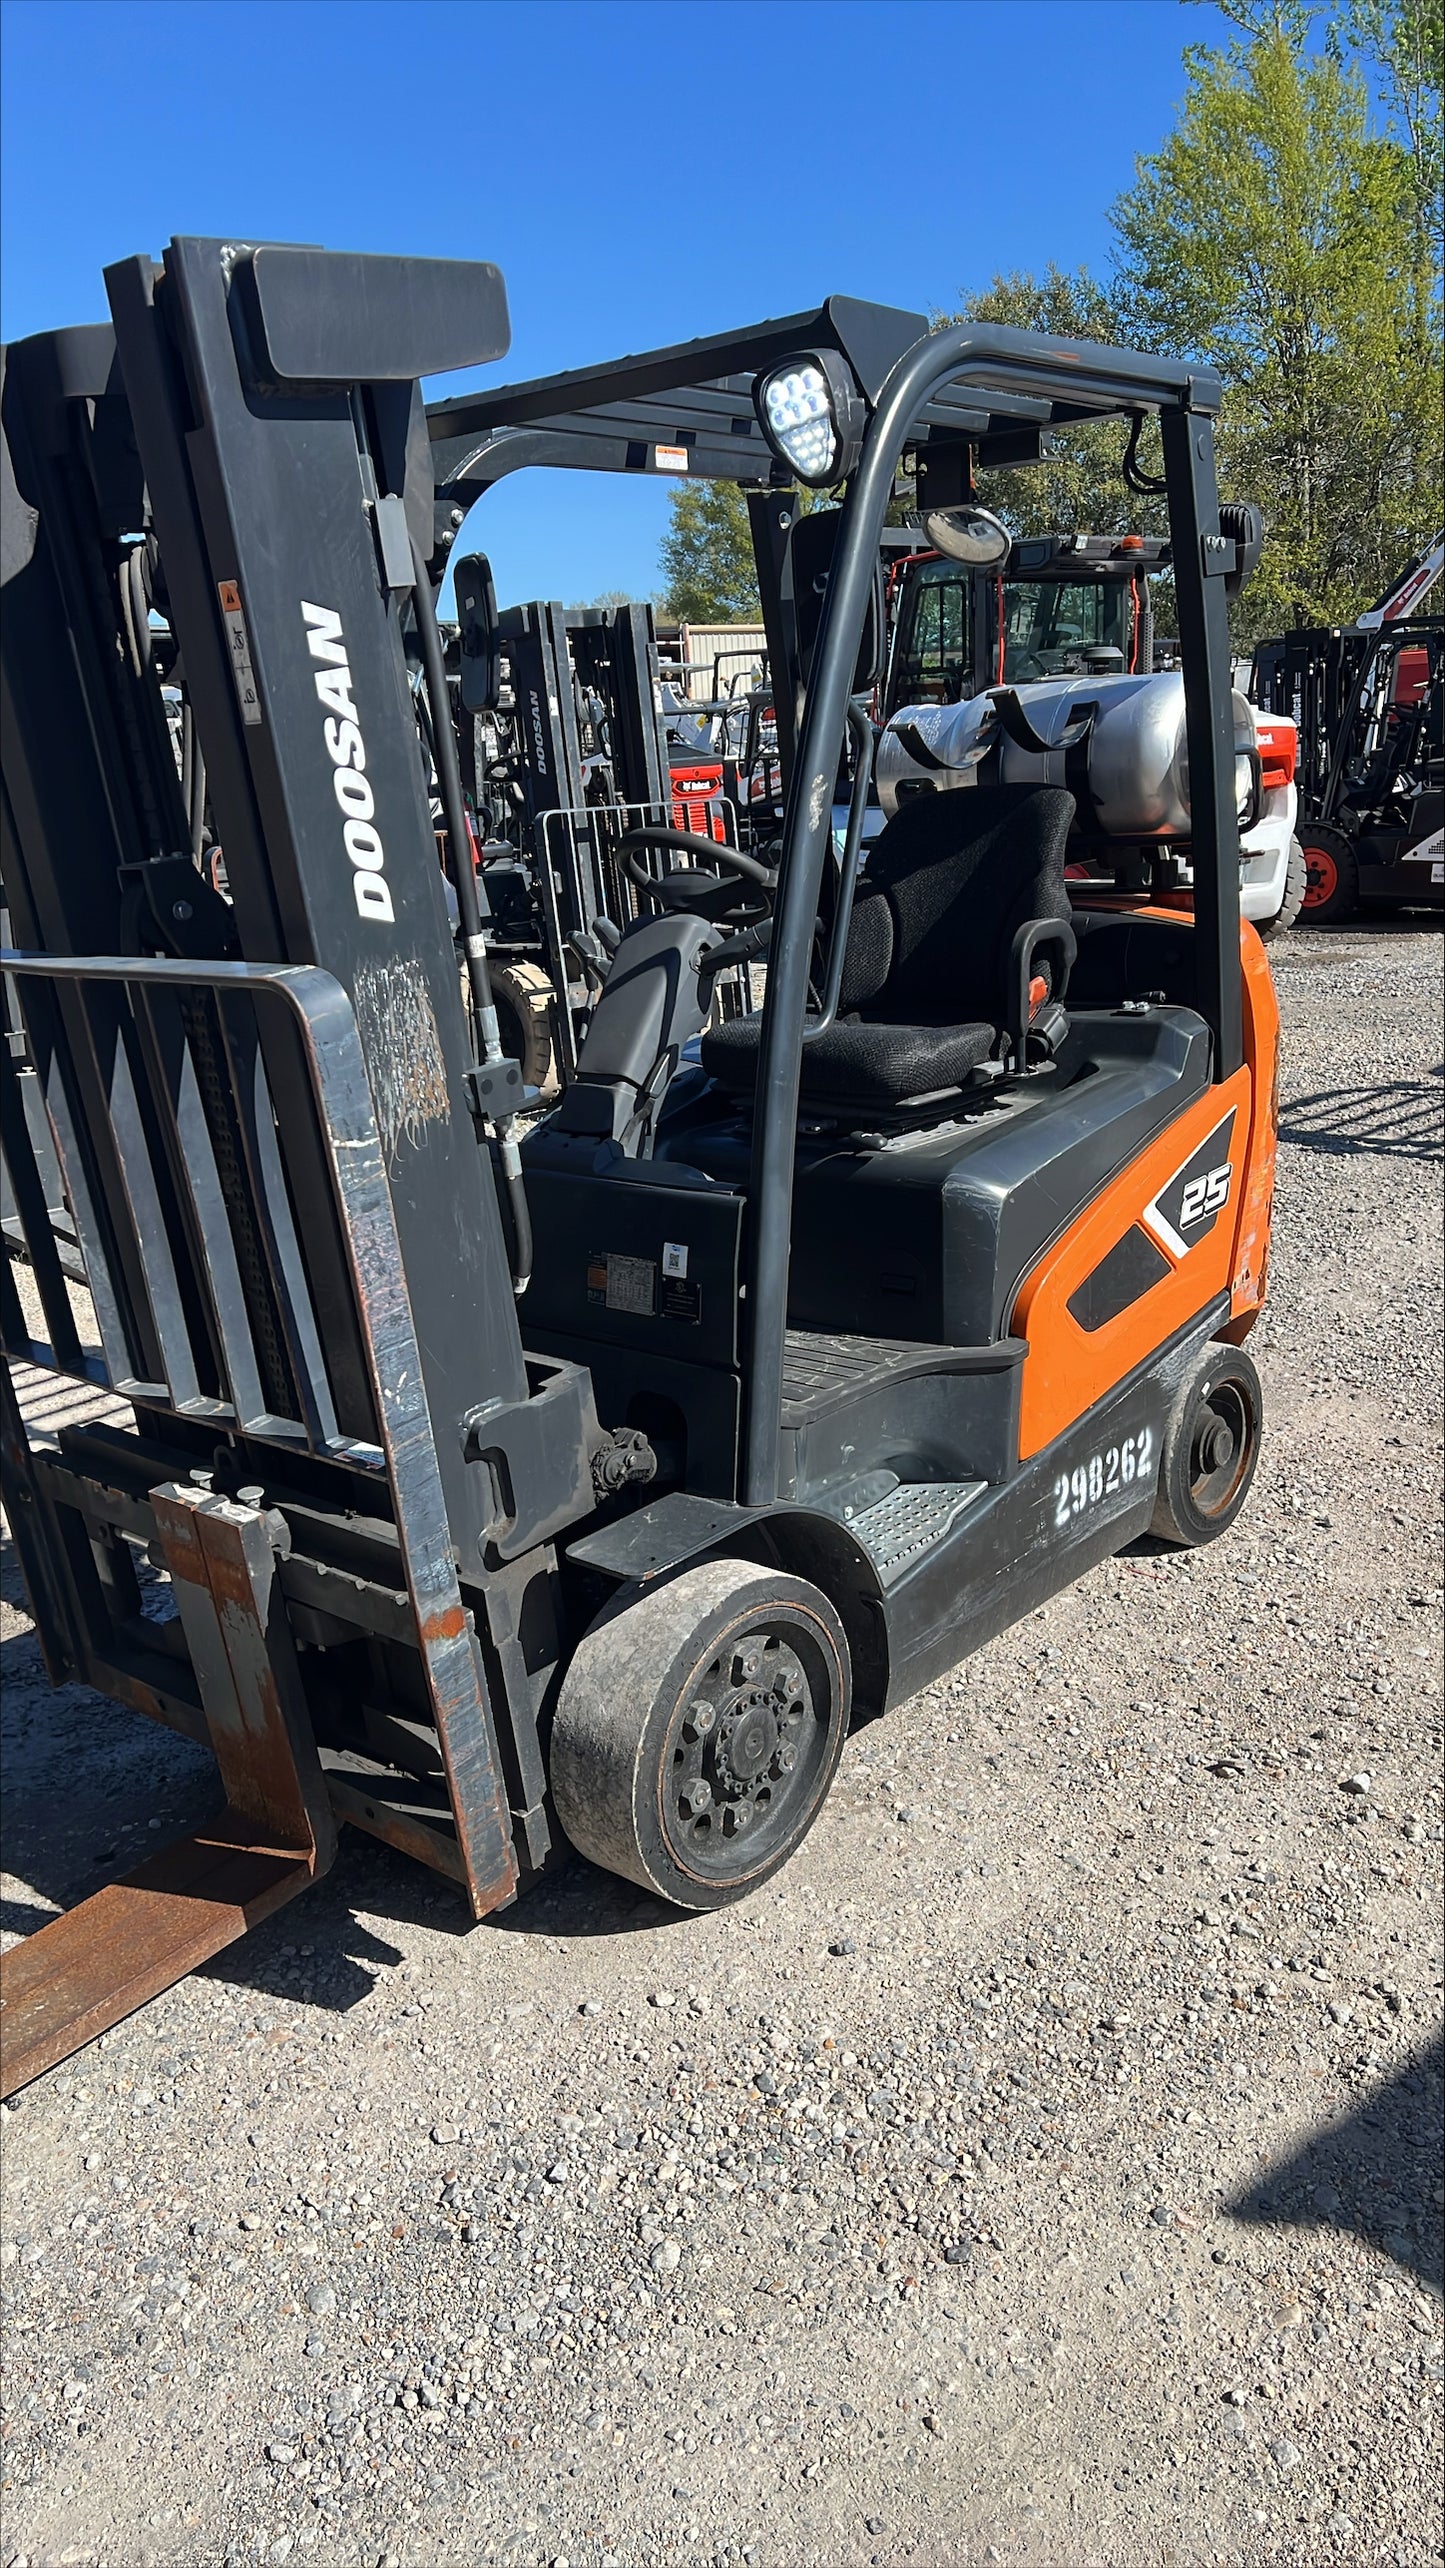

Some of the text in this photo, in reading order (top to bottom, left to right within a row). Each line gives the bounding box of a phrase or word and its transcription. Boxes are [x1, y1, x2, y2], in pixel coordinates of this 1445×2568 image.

[301, 600, 395, 922] DOOSAN
[530, 690, 547, 775] DOOSAN
[1180, 1163, 1231, 1229] 25
[1055, 1427, 1152, 1526] 298262
